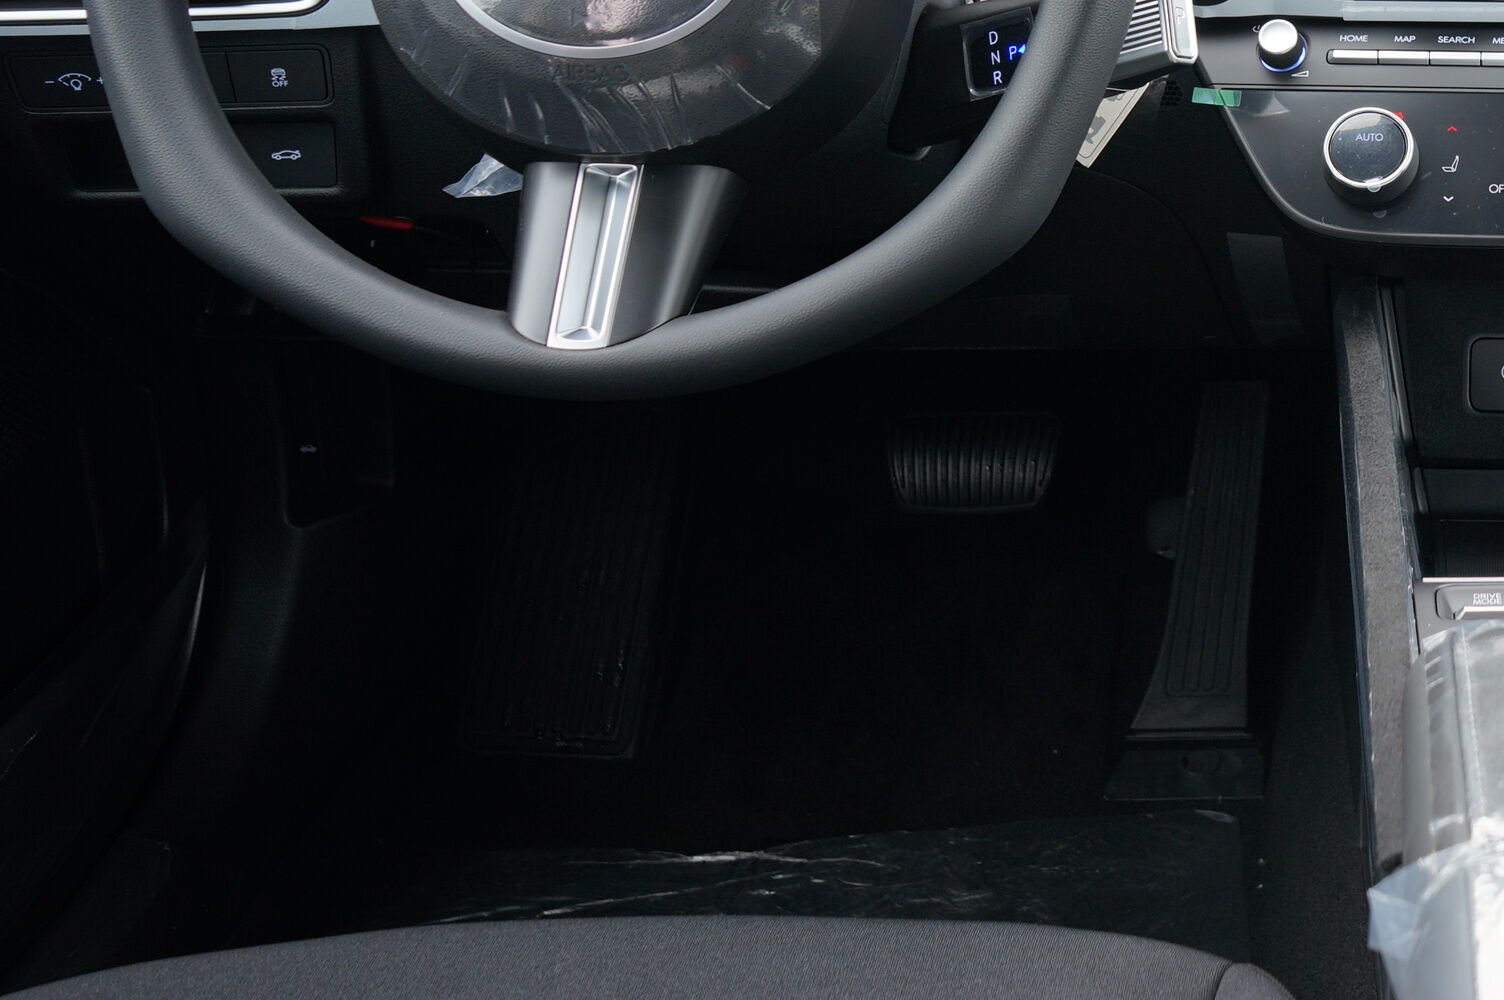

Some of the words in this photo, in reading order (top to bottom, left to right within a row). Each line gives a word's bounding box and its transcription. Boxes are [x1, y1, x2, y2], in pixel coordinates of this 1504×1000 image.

[989, 31, 998, 45] D
[1339, 34, 1368, 43] HOME
[1394, 35, 1416, 43] MAP
[1437, 35, 1475, 44] SEARCH
[1008, 45, 1017, 60] P
[991, 50, 1001, 65] N
[993, 70, 1003, 85] R
[272, 79, 288, 87] OFF
[1355, 133, 1384, 142] AUTO
